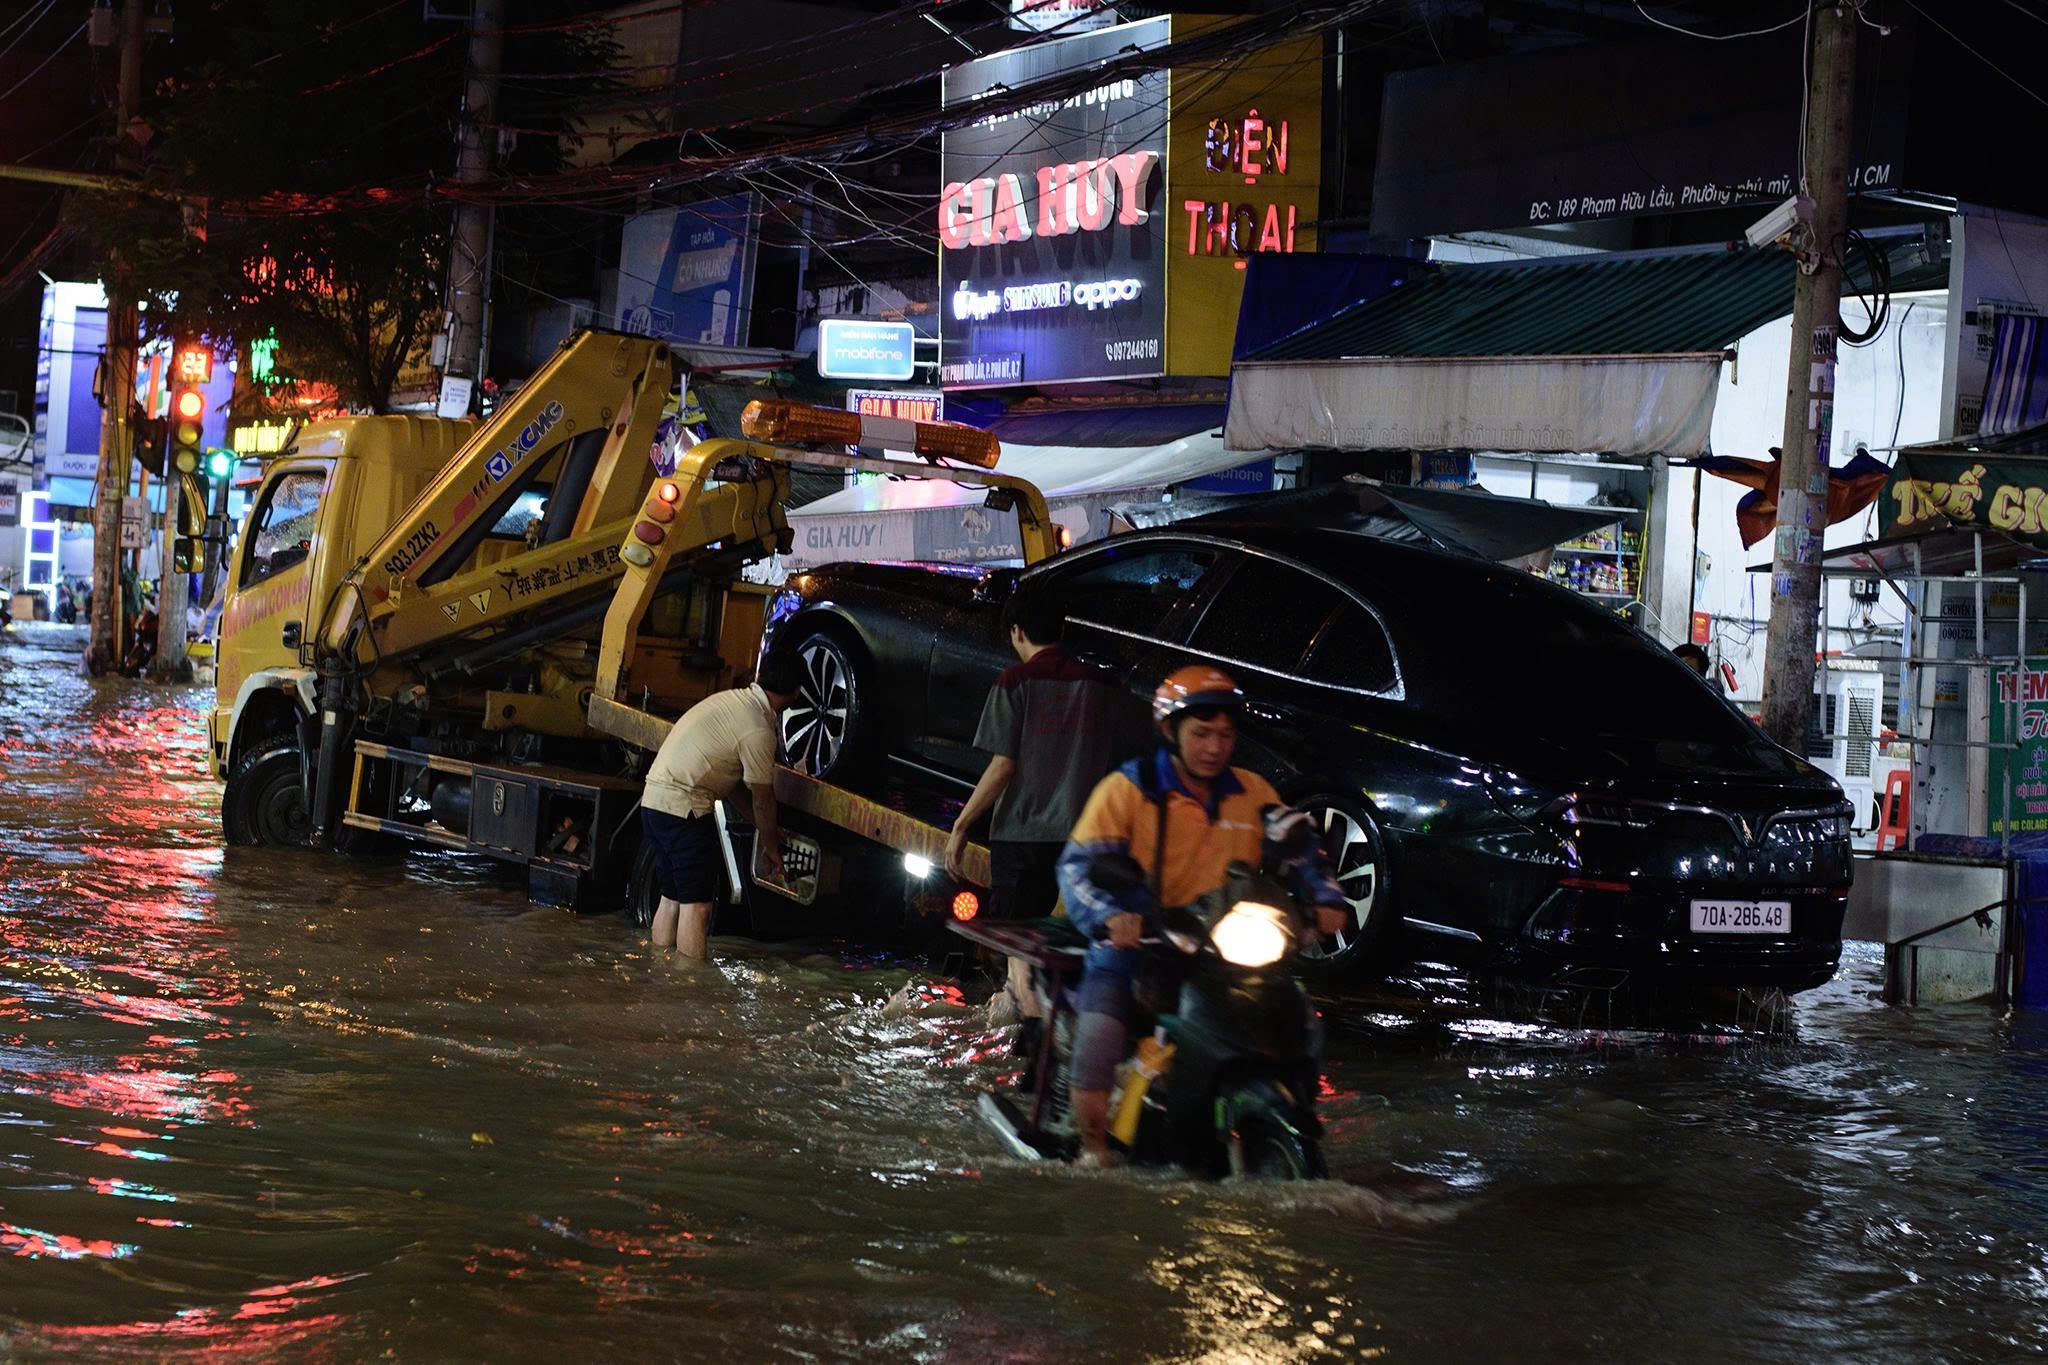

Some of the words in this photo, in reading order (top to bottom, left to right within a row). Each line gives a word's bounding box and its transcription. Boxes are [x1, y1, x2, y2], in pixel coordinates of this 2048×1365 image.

[1204, 108, 1288, 184] ĐIỆN
[939, 173, 1033, 249] GIA
[1036, 151, 1159, 237] HUY
[1556, 198, 1578, 218] 189
[1580, 195, 1616, 217] Phạm
[1620, 190, 1646, 212] Hữu
[1649, 184, 1676, 209] Lầu,
[1184, 200, 1297, 269] THOẠI
[1003, 281, 1071, 312] SAMSUNG
[834, 345, 903, 361] mobifone
[860, 398, 892, 418] GIA
[507, 399, 565, 467] XCMG
[1989, 485, 2048, 535] GI
[806, 526, 833, 549] GIA
[837, 524, 876, 549] HUY
